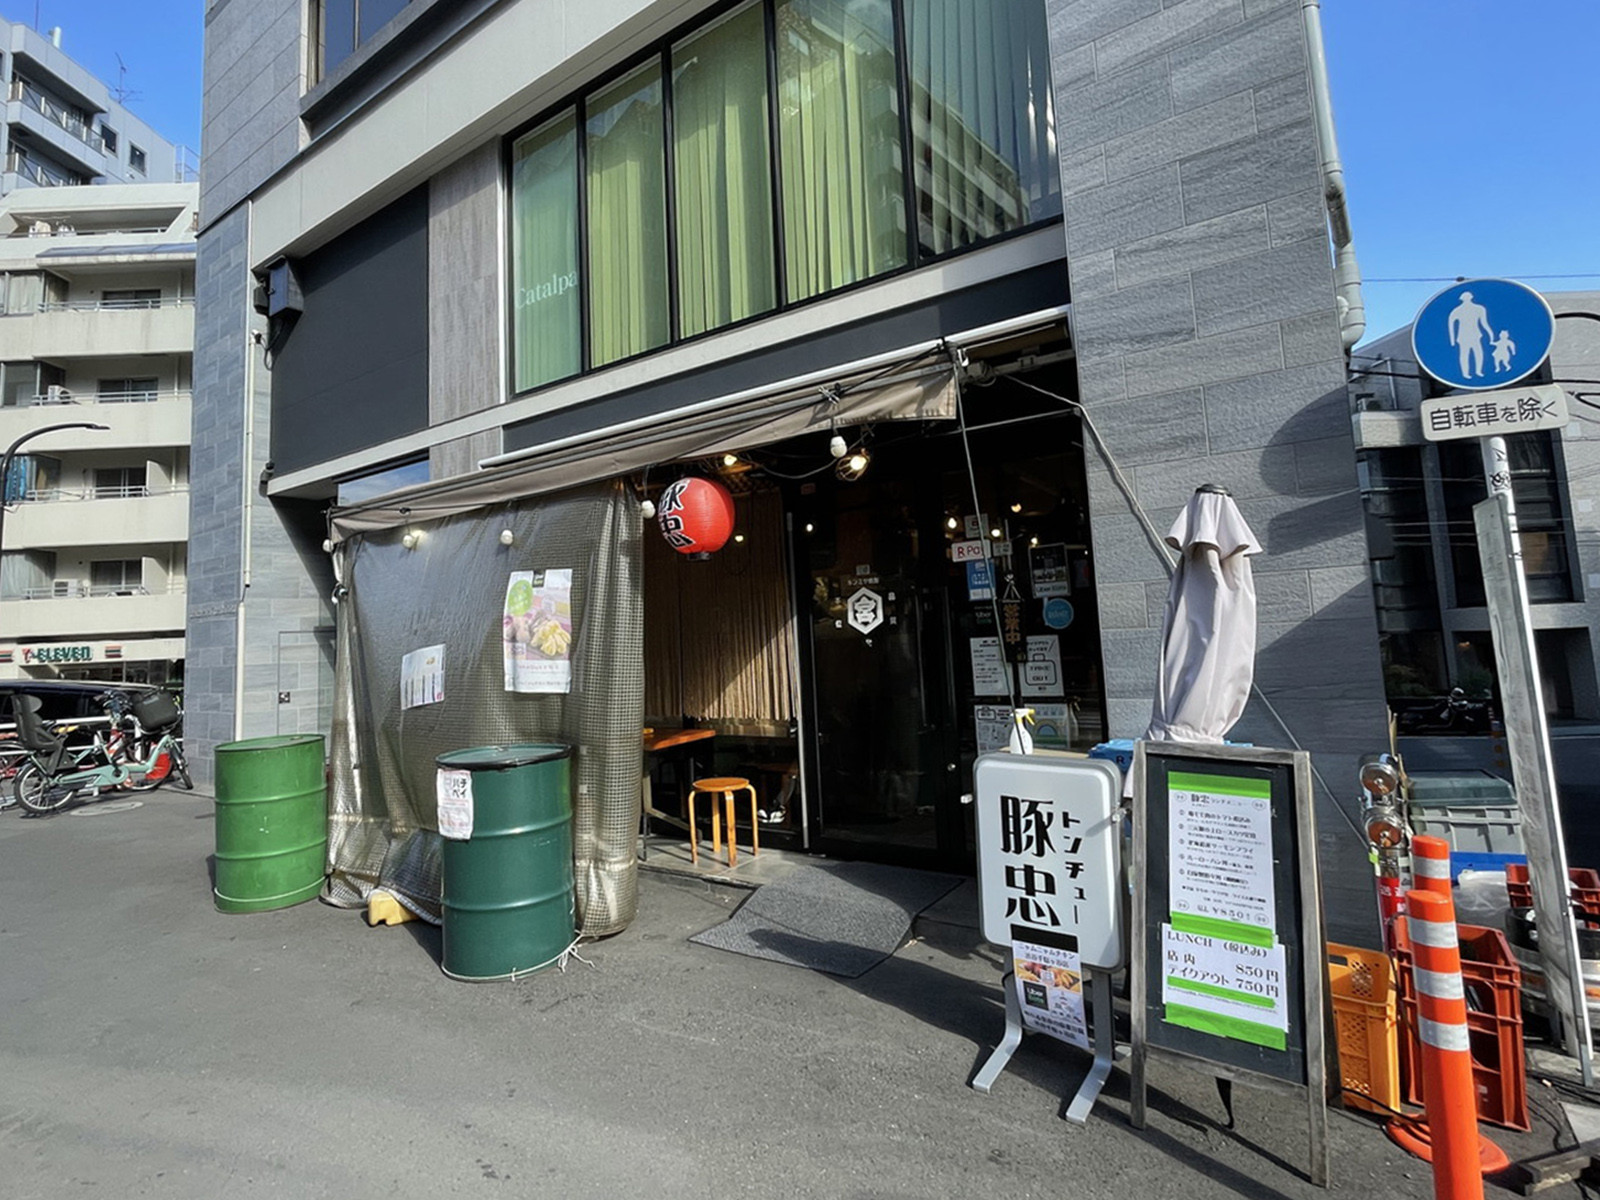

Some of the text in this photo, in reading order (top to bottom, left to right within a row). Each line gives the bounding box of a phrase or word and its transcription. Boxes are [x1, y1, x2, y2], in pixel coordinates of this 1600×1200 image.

[1430, 397, 1558, 431] 自転車を除く
[1003, 603, 1020, 644] 営業中
[1000, 795, 1061, 927] 豚忠
[1062, 811, 1087, 925] トンチュー
[1167, 931, 1212, 947] LUNCH
[1168, 965, 1229, 985] テイクアウト
